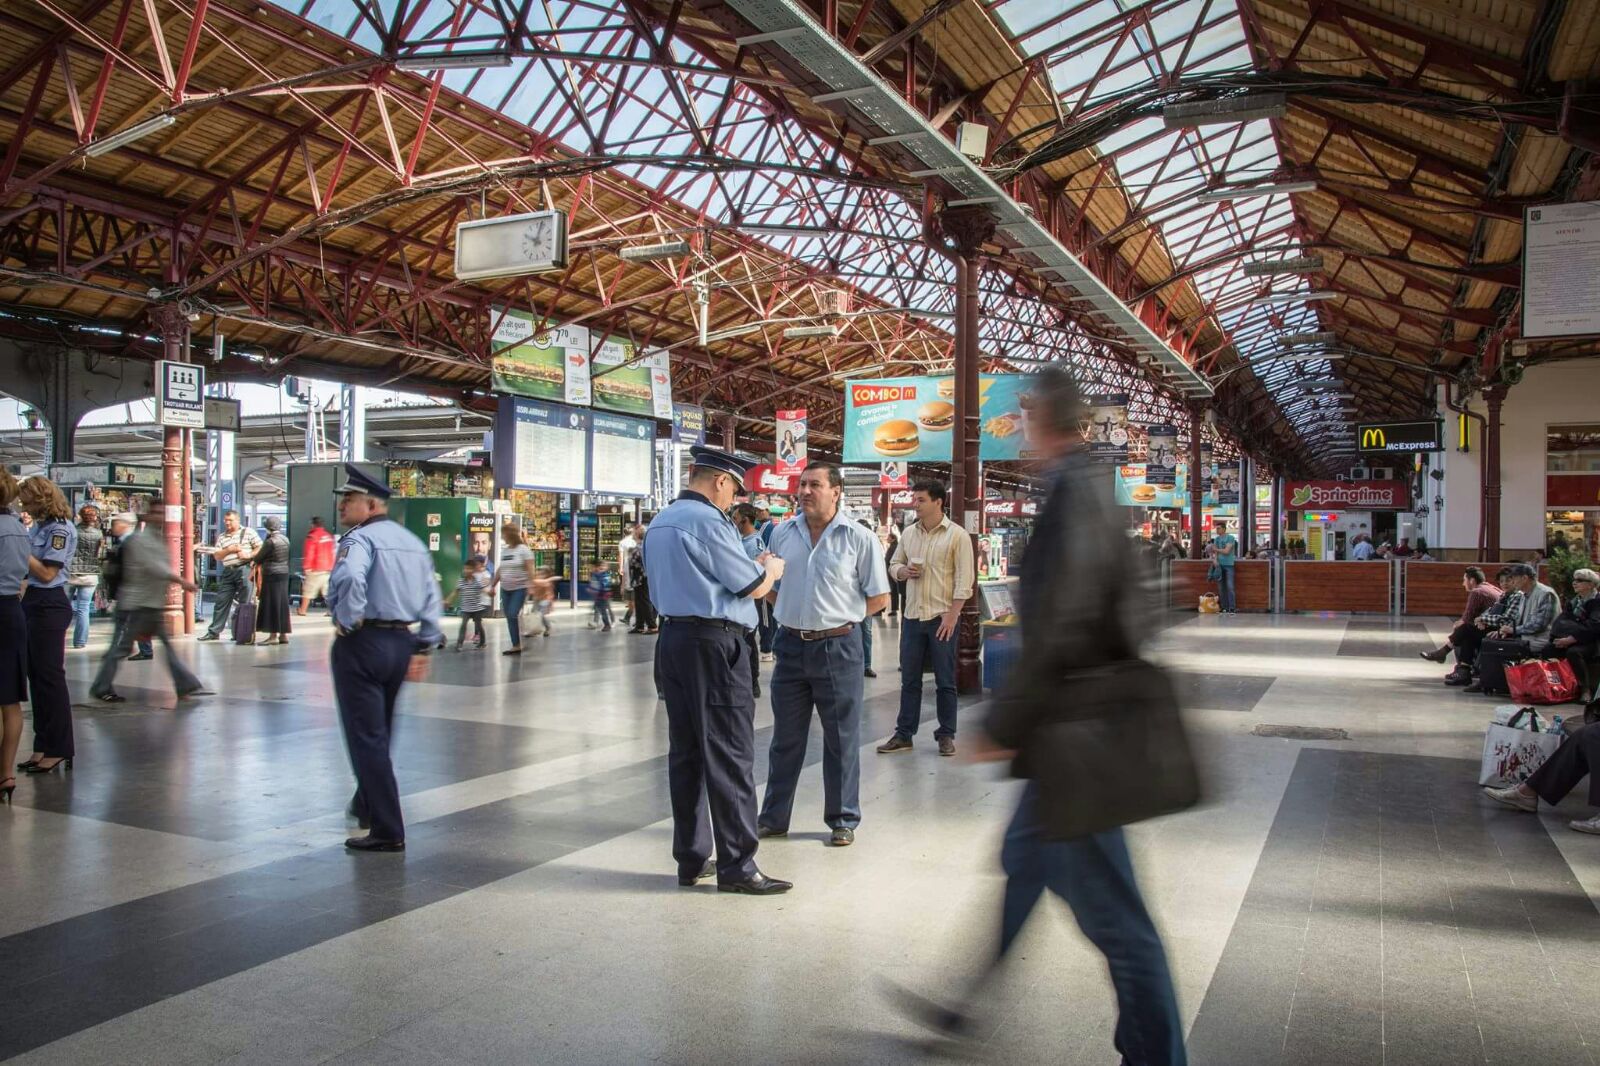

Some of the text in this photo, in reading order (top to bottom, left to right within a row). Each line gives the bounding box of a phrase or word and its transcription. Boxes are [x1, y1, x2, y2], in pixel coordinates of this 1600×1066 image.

[854, 387, 900, 401] COMBO
[681, 410, 703, 421] SQUAD
[682, 420, 703, 431] FORCE
[1386, 441, 1436, 451] McExpress
[1310, 486, 1393, 505] Springtime
[470, 515, 494, 527] Amigo
